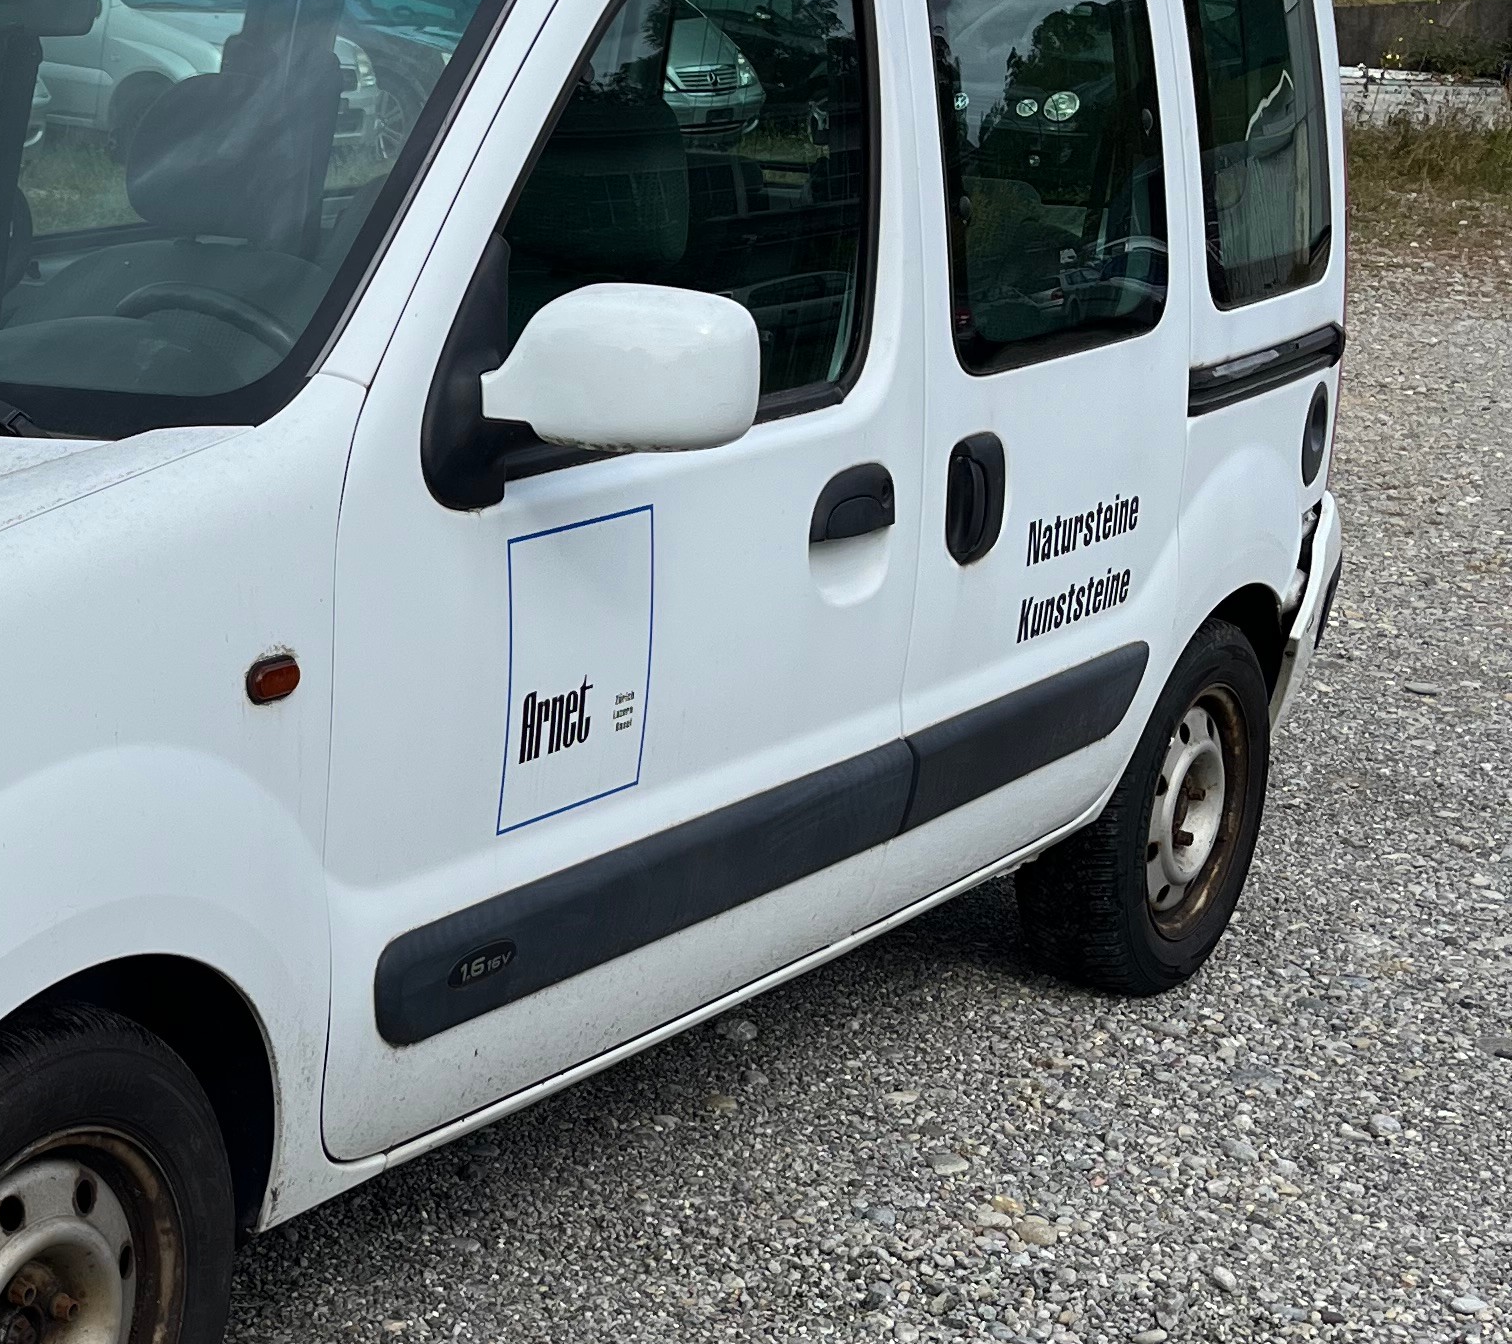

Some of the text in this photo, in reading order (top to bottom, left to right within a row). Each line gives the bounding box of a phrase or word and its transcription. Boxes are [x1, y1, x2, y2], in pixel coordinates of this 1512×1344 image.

[1026, 493, 1140, 567] Natursteine
[1016, 567, 1131, 644] Kunststeine
[518, 674, 594, 765] Arnet
[460, 951, 513, 982] 1.6 16V
